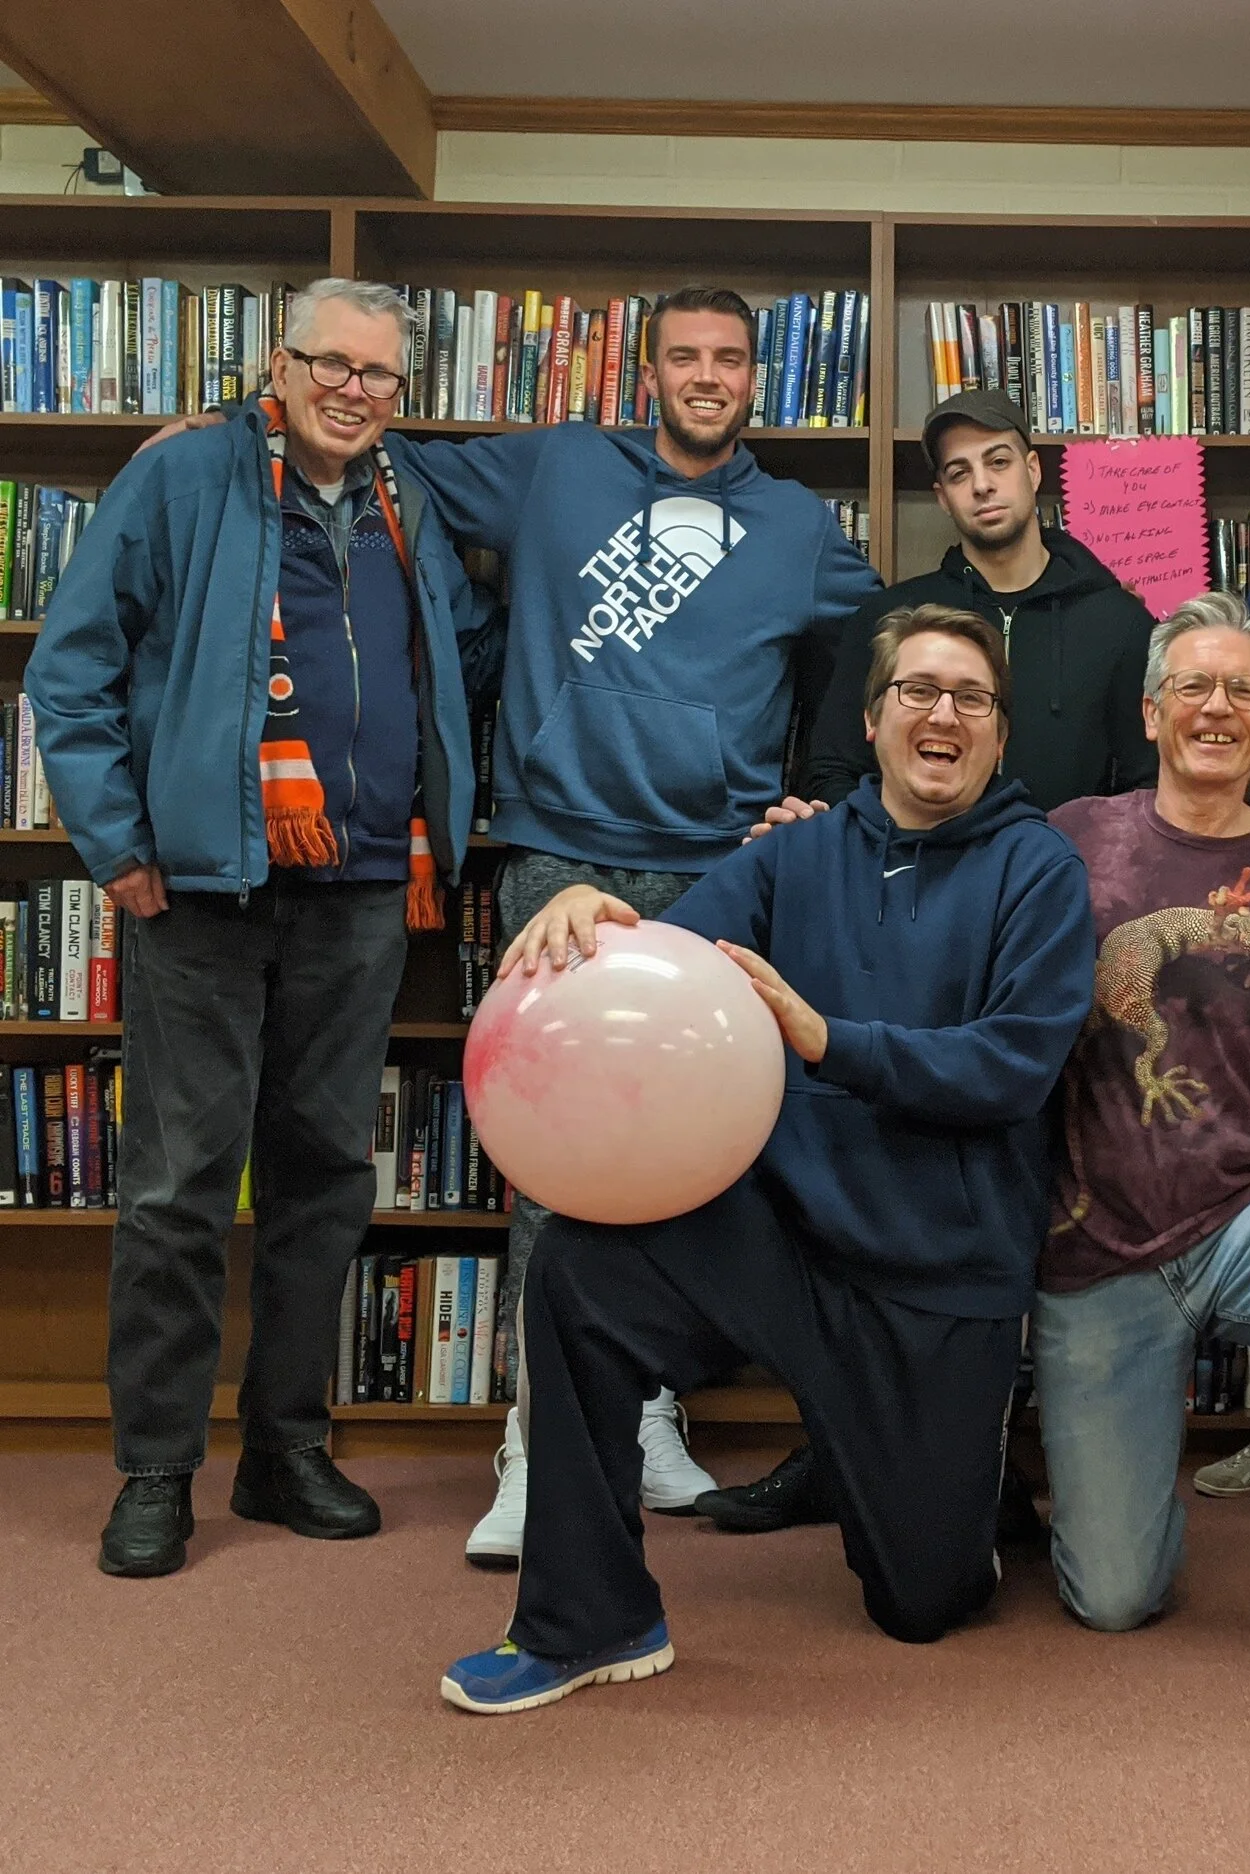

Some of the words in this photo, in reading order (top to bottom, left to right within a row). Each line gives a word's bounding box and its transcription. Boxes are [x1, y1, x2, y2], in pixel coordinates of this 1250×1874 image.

[208, 290, 219, 315] DAVID
[224, 289, 235, 315] DAVID
[416, 291, 426, 332] CATHERINE
[793, 298, 803, 330] JANET
[844, 294, 854, 320] LINDA
[777, 304, 786, 328] JANET
[1209, 310, 1220, 323] TIM
[208, 318, 219, 358] BALDACCI
[223, 318, 235, 360] BALDACCI
[775, 330, 785, 358] DAILEY
[842, 324, 852, 354] DAVIES
[1094, 323, 1103, 341] LUCY
[1138, 312, 1152, 355] HEATHER
[1209, 325, 1220, 348] GREEN
[414, 334, 426, 370] COULTER
[556, 330, 570, 366] CRAIS
[790, 332, 802, 367] DAILEY
[819, 363, 827, 384] LINDA
[1008, 356, 1021, 380] DEADLY
[1030, 358, 1042, 376] LATE
[1049, 354, 1058, 378] Bounty
[1140, 357, 1153, 396] GRAHAM
[1210, 354, 1220, 390] AMERICAN
[222, 376, 231, 400] JUSTICE
[785, 374, 796, 408] Illusions
[1228, 362, 1236, 402] KINGDOM
[816, 388, 825, 414] DAVIES
[1211, 393, 1221, 426] OUTRAGE
[1098, 466, 1128, 478] TAKE
[1130, 466, 1160, 477] CARE
[1164, 463, 1182, 474] OF
[1124, 482, 1147, 495] YOU
[1083, 501, 1096, 515] 2)
[1100, 504, 1130, 516] MAKE
[1137, 501, 1158, 512] EYE
[41, 522, 51, 551] Stephen
[1083, 529, 1095, 547] 3)
[40, 552, 49, 575] Baxter
[578, 521, 642, 588] THE
[1138, 549, 1179, 564] SPACE
[38, 580, 48, 608] Winter
[47, 576, 55, 592] Iron
[570, 541, 676, 663] NORTH
[615, 562, 701, 653] FACE
[22, 697, 31, 726] GERALD
[21, 736, 32, 767] BROWNE
[39, 887, 51, 911] TOM
[70, 888, 81, 911] TOM
[101, 894, 114, 912] TOM
[38, 914, 51, 959] CLANCY
[68, 915, 81, 959] CLANCY
[101, 917, 115, 952] CLANCY
[463, 907, 474, 942] FAIRSTEIN
[45, 1075, 64, 1097] ROBIN
[70, 1069, 78, 1089] LUCKY
[20, 1093, 28, 1116] LAST
[45, 1098, 64, 1117] COOK
[70, 1092, 79, 1109] STIFF
[22, 1119, 30, 1151] TRADE
[72, 1129, 80, 1156] DEBORAH
[72, 1158, 81, 1185] COONTS
[468, 1158, 479, 1191] FRANZEN
[399, 1268, 414, 1315] VERTICAL
[478, 1269, 486, 1315] GIDEON
[440, 1291, 453, 1321] HIDE
[440, 1344, 448, 1358] LISA
[455, 1340, 468, 1356] ICE
[454, 1359, 468, 1390] COLD
